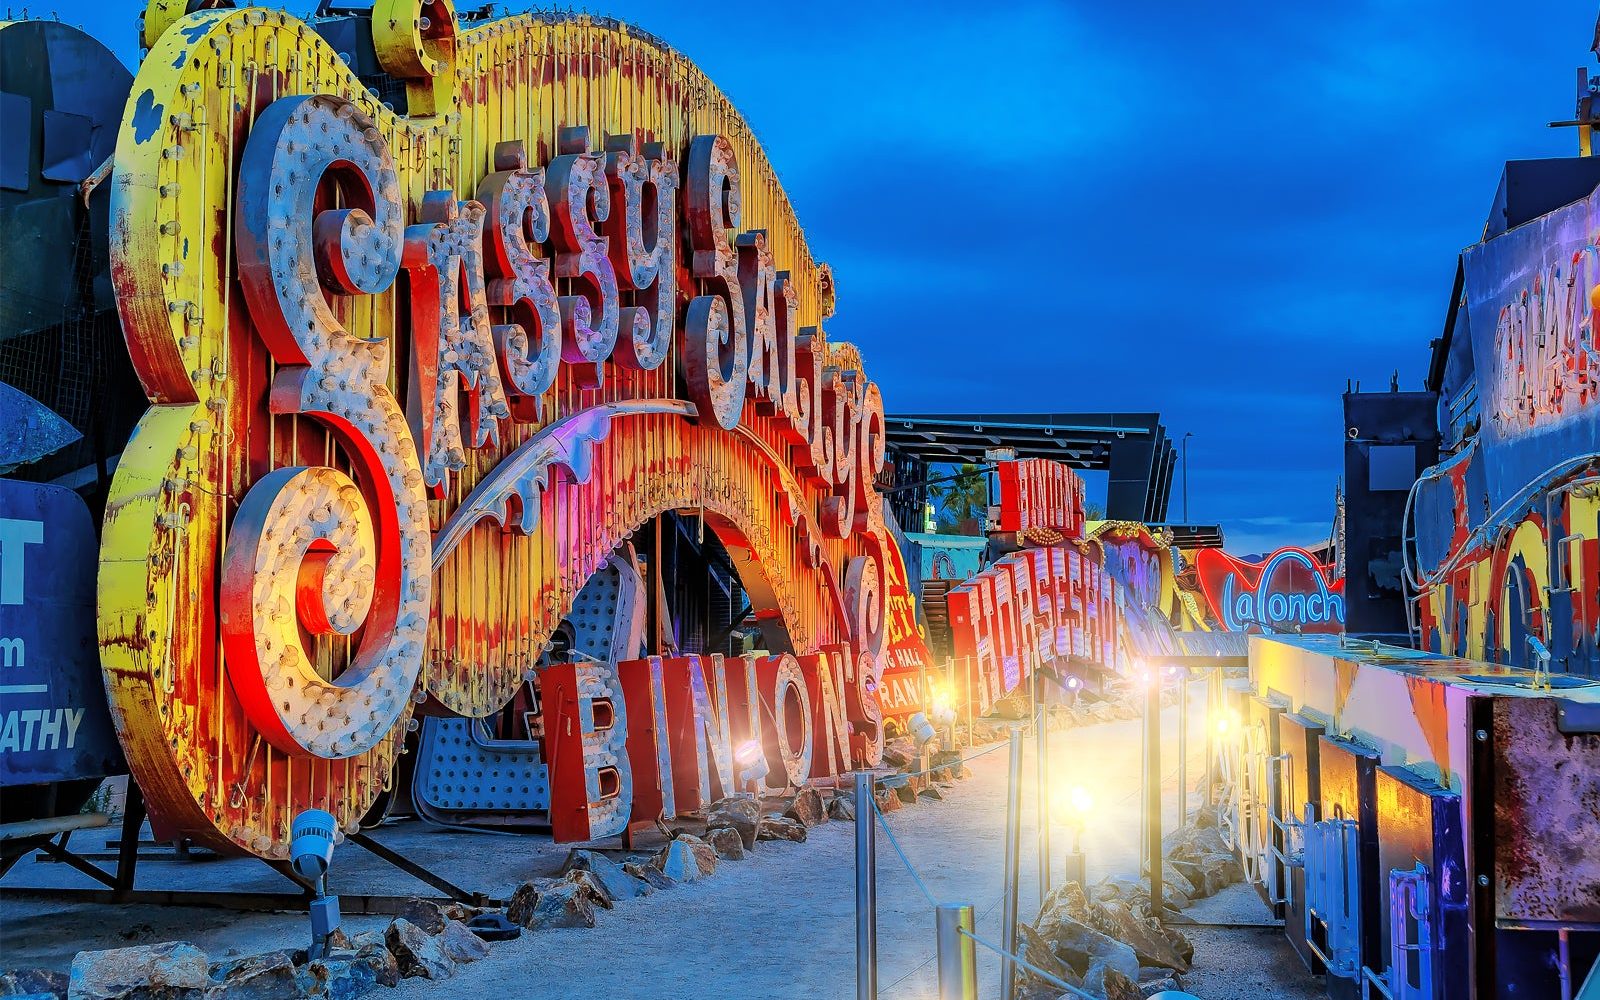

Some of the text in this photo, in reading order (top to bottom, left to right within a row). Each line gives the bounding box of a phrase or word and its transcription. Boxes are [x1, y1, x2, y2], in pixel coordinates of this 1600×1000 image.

[895, 647, 924, 668] HALL
[0, 707, 86, 754] ATHY
[568, 640, 884, 843] BINION'S
